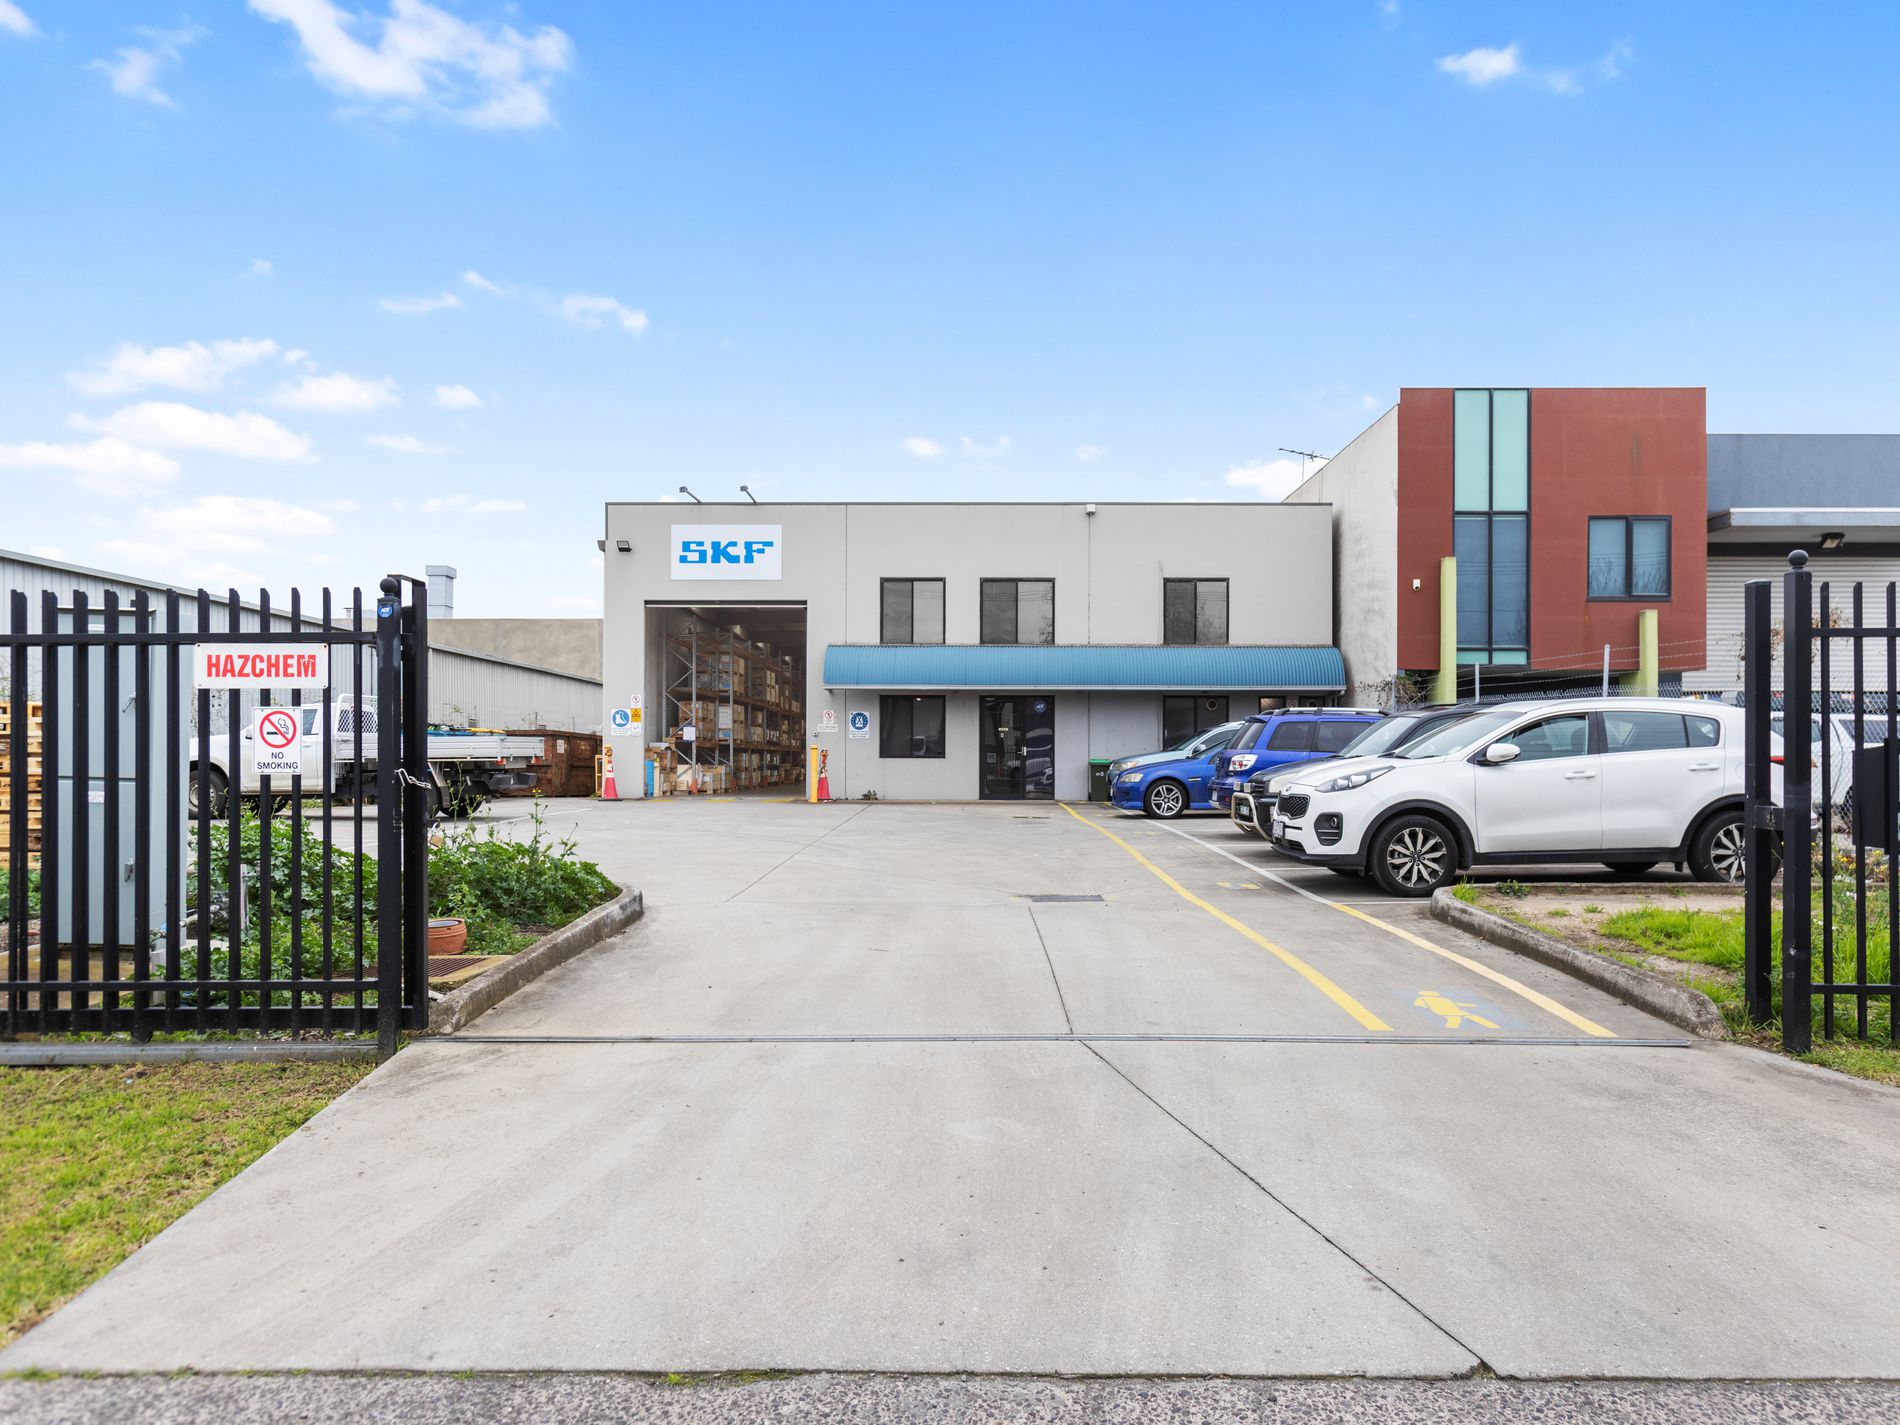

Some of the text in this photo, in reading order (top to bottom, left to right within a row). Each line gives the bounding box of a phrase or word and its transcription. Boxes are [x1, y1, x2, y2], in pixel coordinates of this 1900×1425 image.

[679, 541, 774, 563] SKF
[206, 653, 317, 678] HAZCHEM
[271, 752, 285, 760] NO
[256, 761, 299, 770] SMOKING
